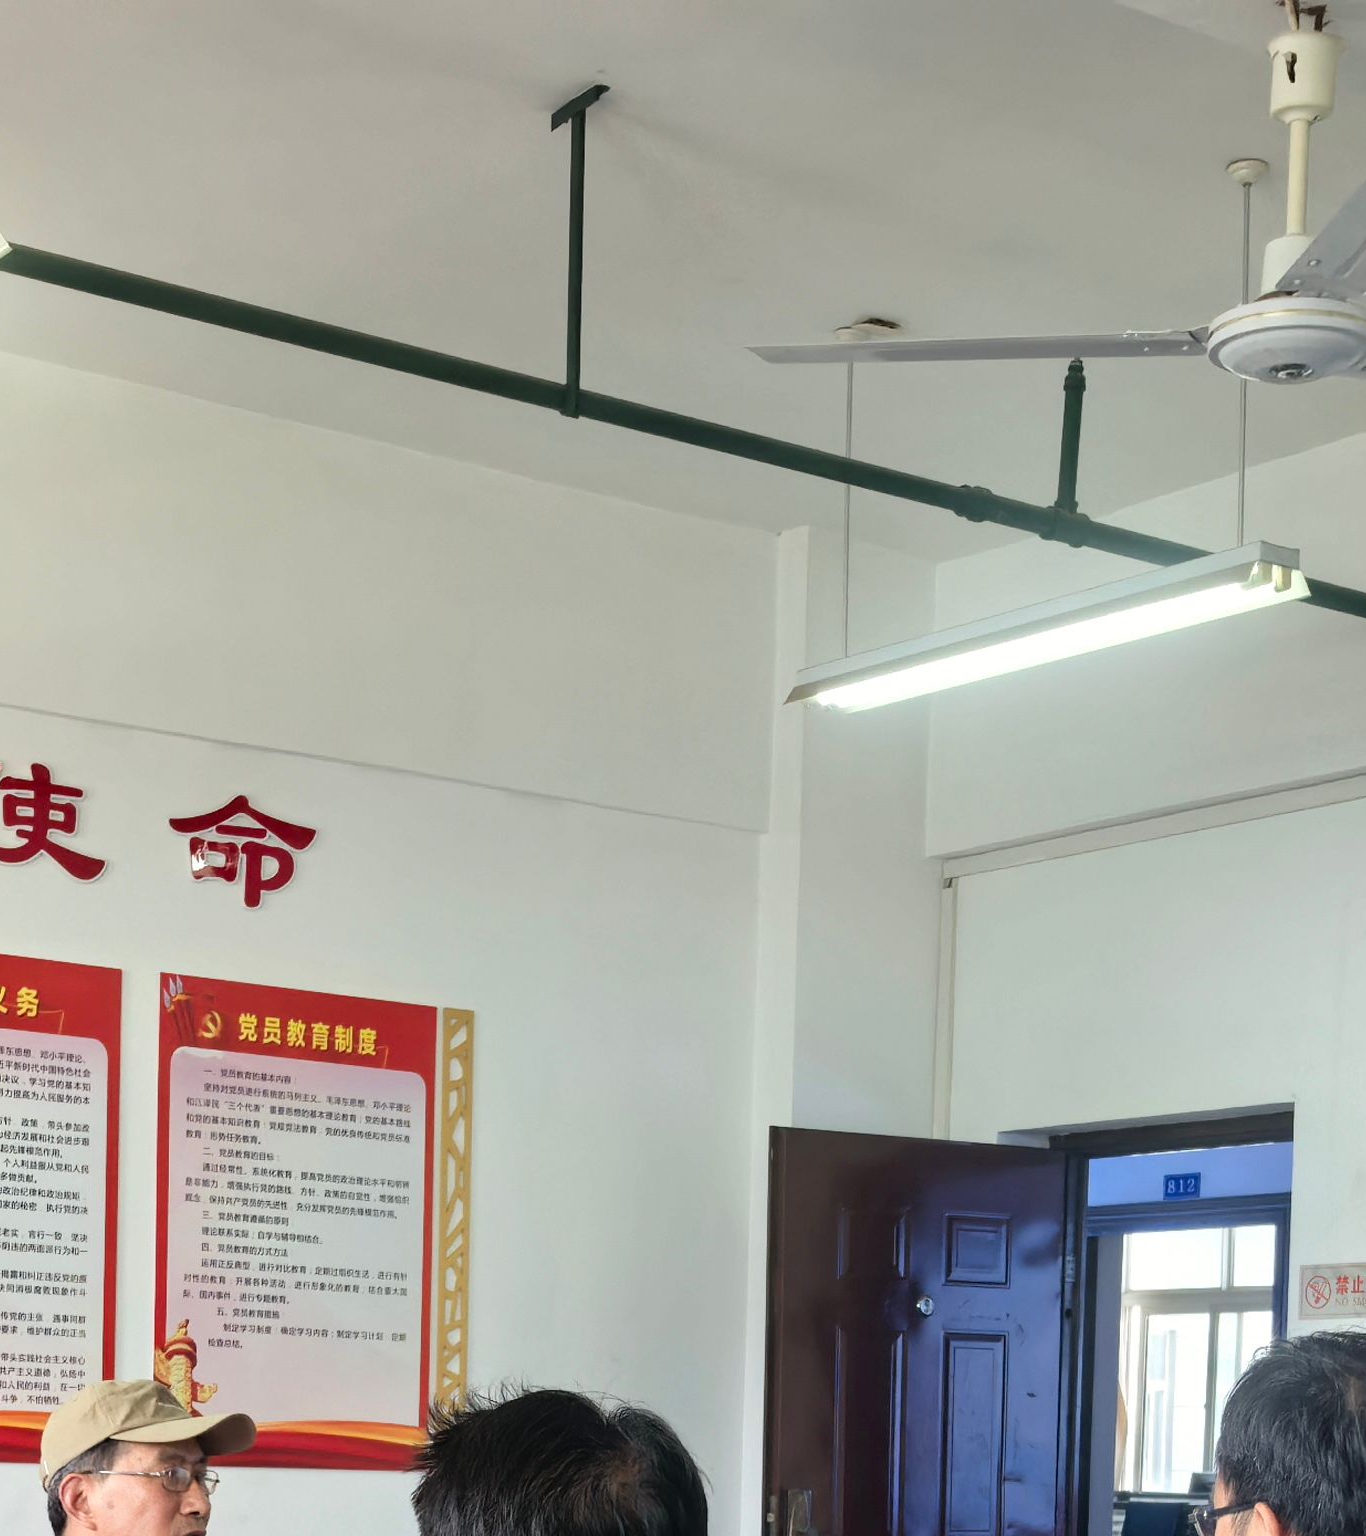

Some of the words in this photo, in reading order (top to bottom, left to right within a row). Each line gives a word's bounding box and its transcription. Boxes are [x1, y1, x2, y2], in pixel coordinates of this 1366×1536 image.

[238, 1013, 378, 1056] 党员教育制度
[1167, 1178, 1195, 1194] 812
